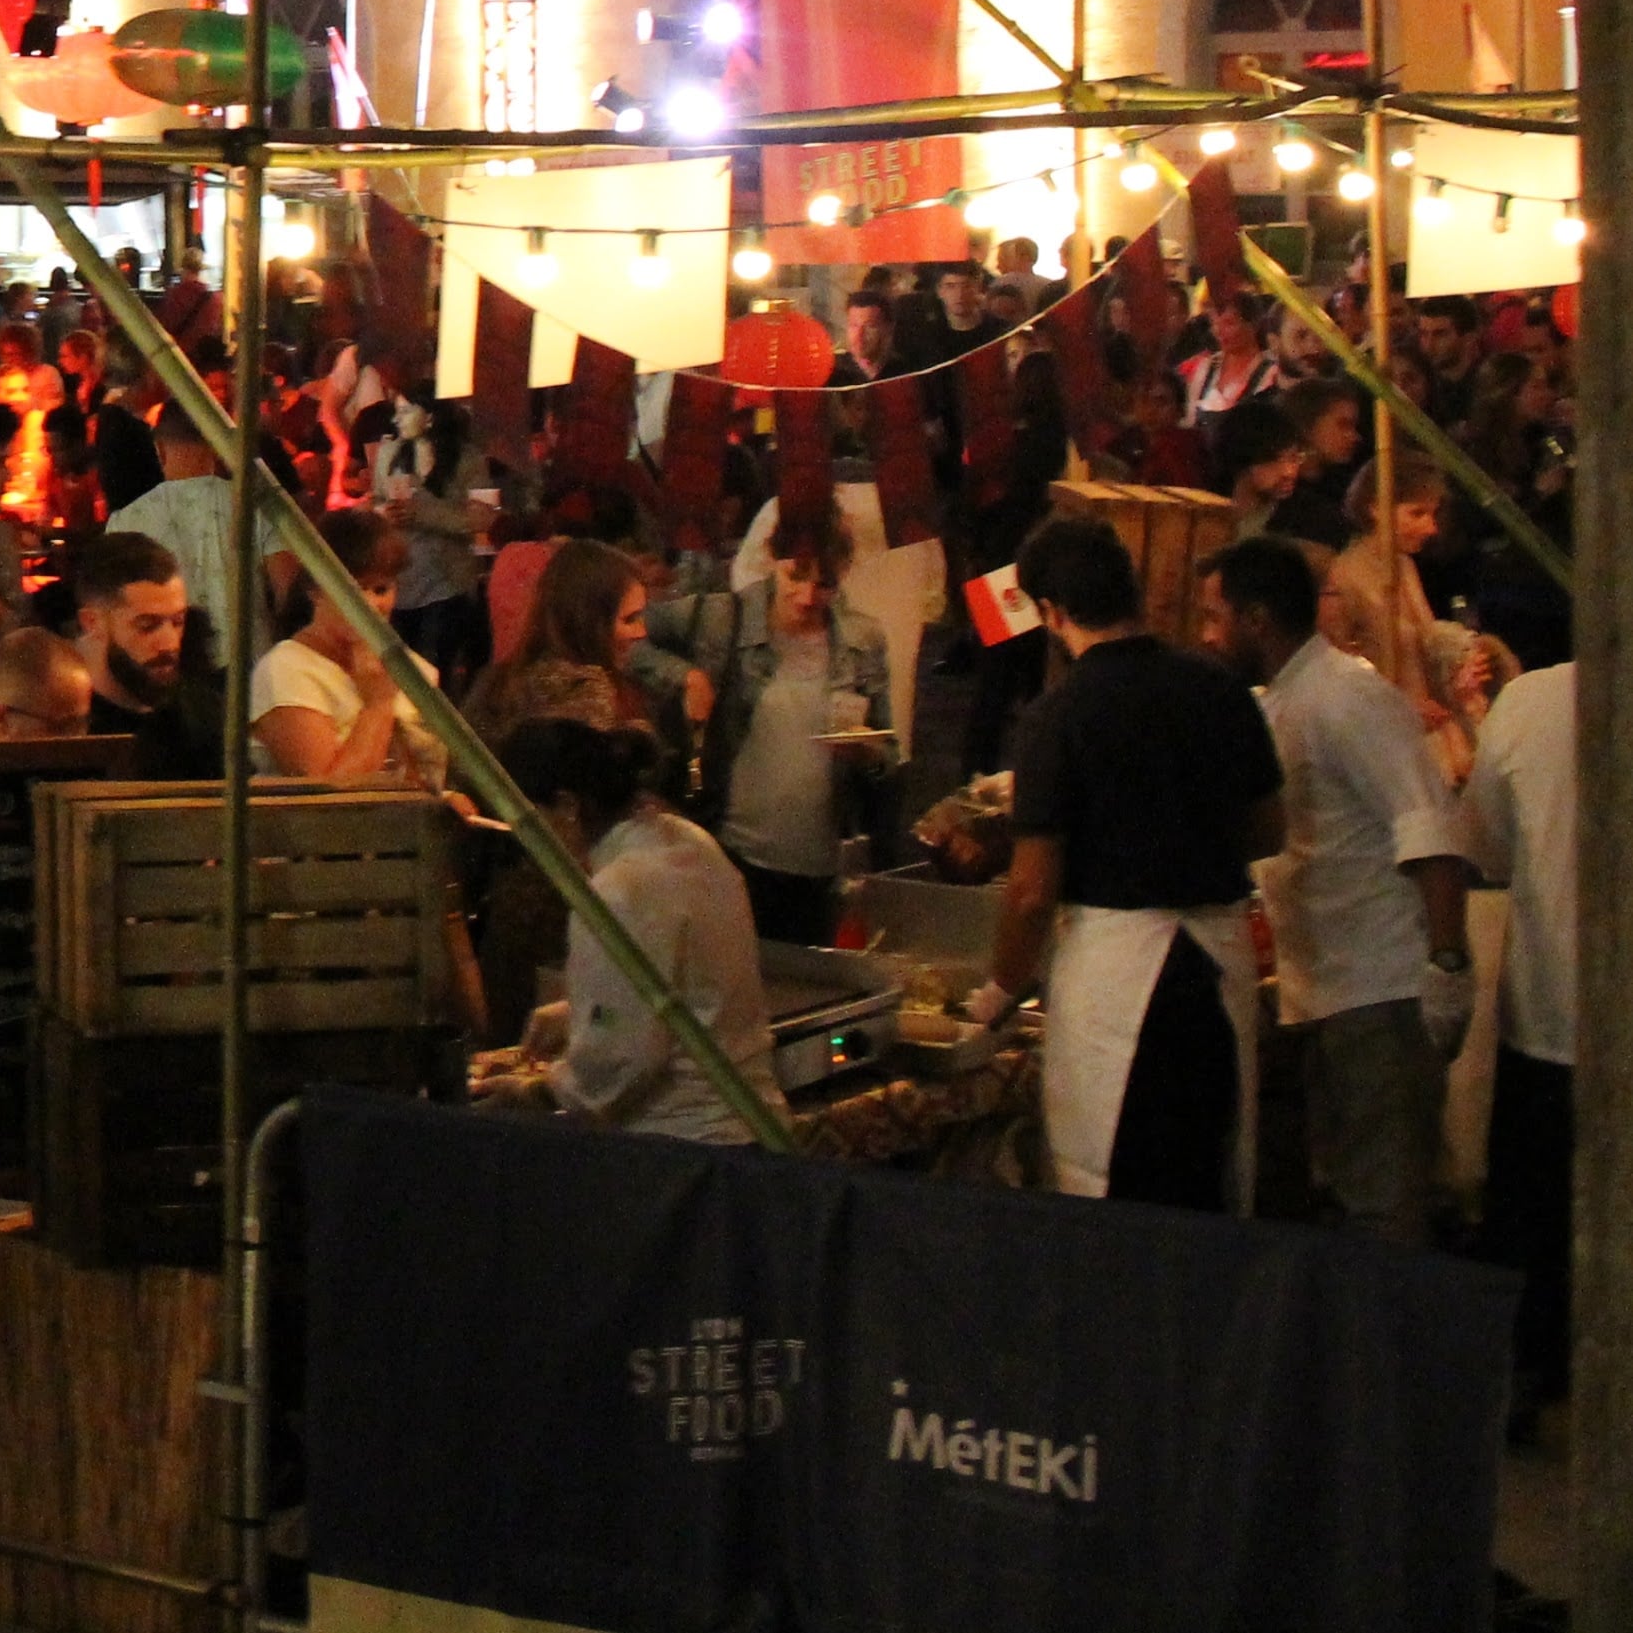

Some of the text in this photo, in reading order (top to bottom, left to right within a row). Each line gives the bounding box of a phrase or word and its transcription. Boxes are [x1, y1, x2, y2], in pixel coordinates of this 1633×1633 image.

[798, 137, 924, 192] STREET
[627, 1338, 808, 1394] STREET
[665, 1389, 783, 1443] FOOD
